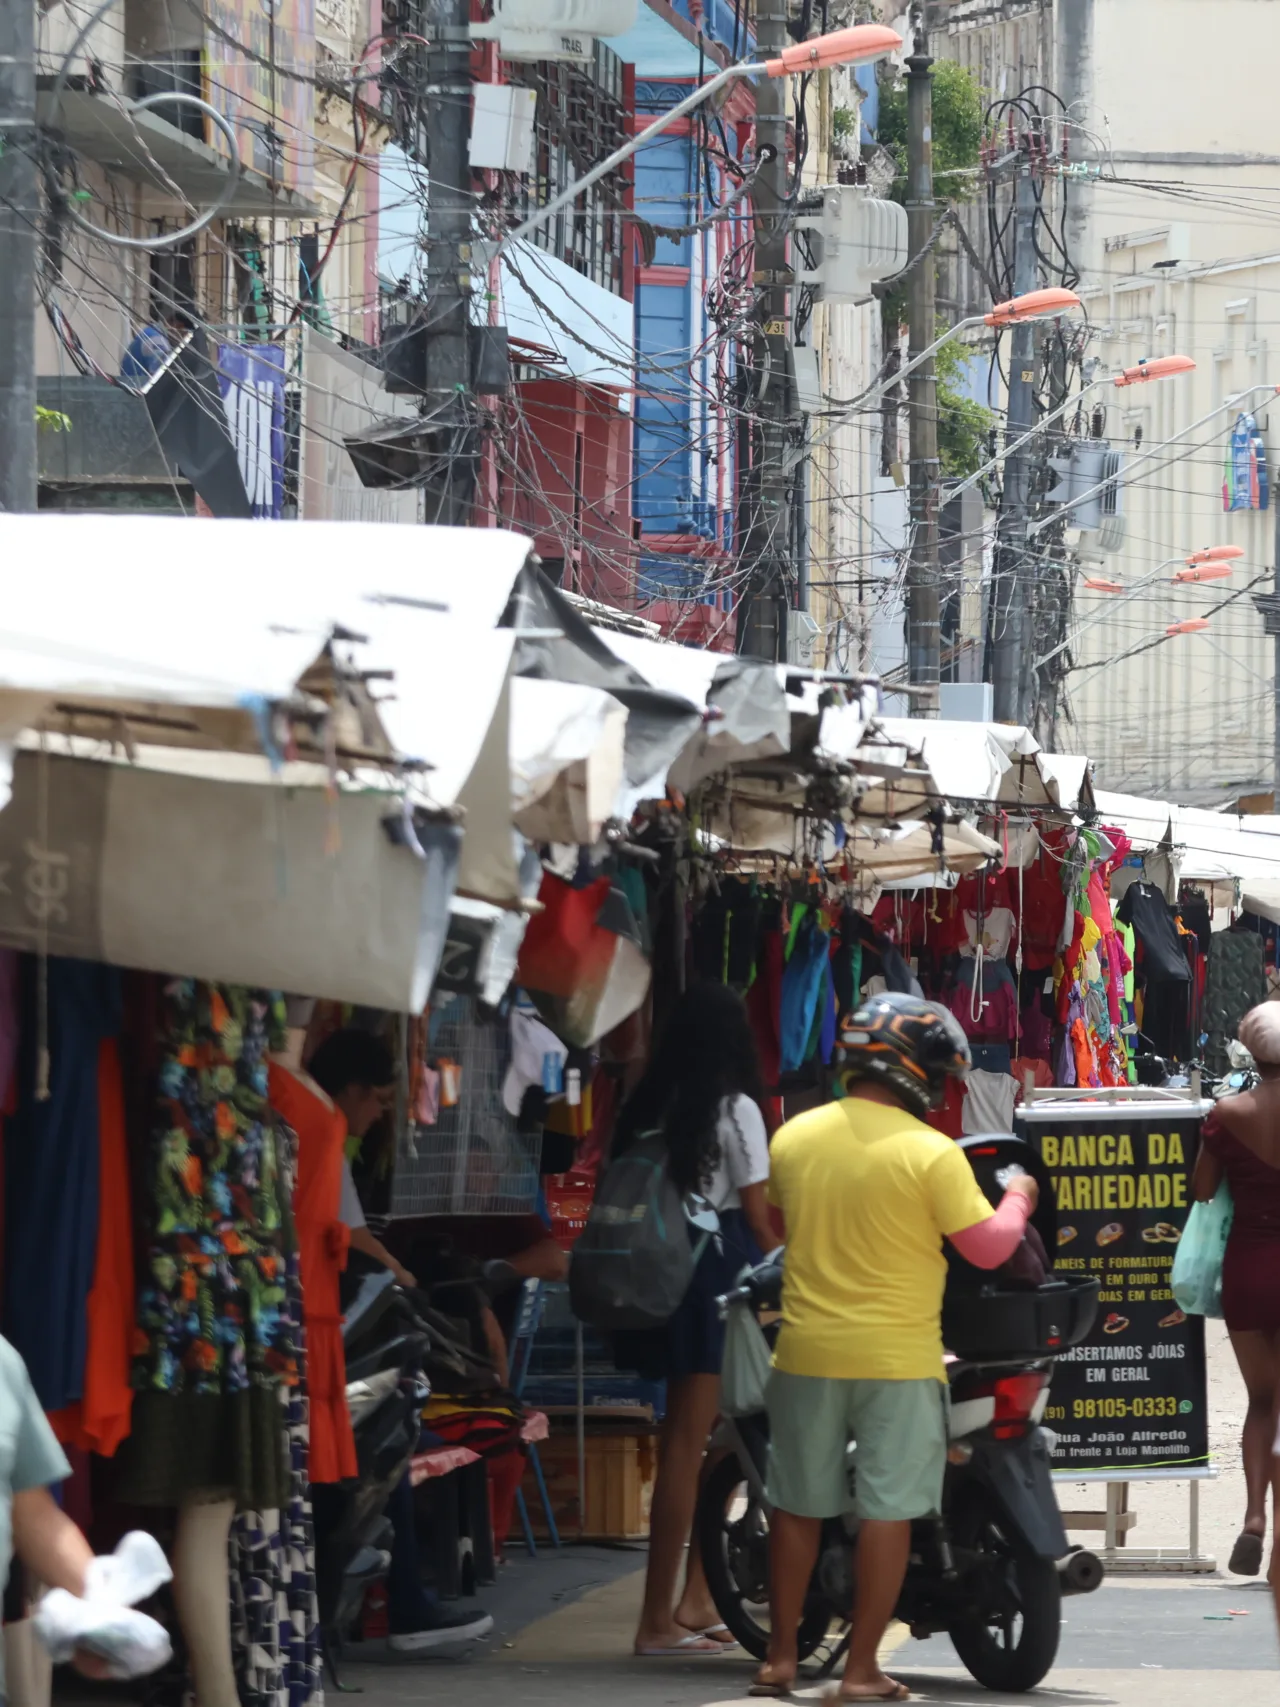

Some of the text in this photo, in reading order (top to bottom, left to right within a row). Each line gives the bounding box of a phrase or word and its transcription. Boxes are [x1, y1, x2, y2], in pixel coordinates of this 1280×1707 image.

[561, 37, 583, 53] TRAEL
[1041, 1133, 1185, 1167] BANCA DA
[1090, 1257, 1104, 1269] DE
[1106, 1274, 1124, 1286] EM
[1128, 1273, 1158, 1285] OURO
[1128, 1290, 1146, 1301] EM
[1054, 1342, 1185, 1362] ONSERTAMOS JÓIAS
[1086, 1367, 1150, 1383] EM GERAL
[1044, 1397, 1177, 1420] (91) 98105-0333
[1087, 1431, 1125, 1443] João
[1131, 1429, 1187, 1442] Alfredo
[1051, 1449, 1065, 1457] em
[1070, 1446, 1101, 1457] frente
[1105, 1448, 1112, 1456] a
[1116, 1446, 1137, 1457] Loja
